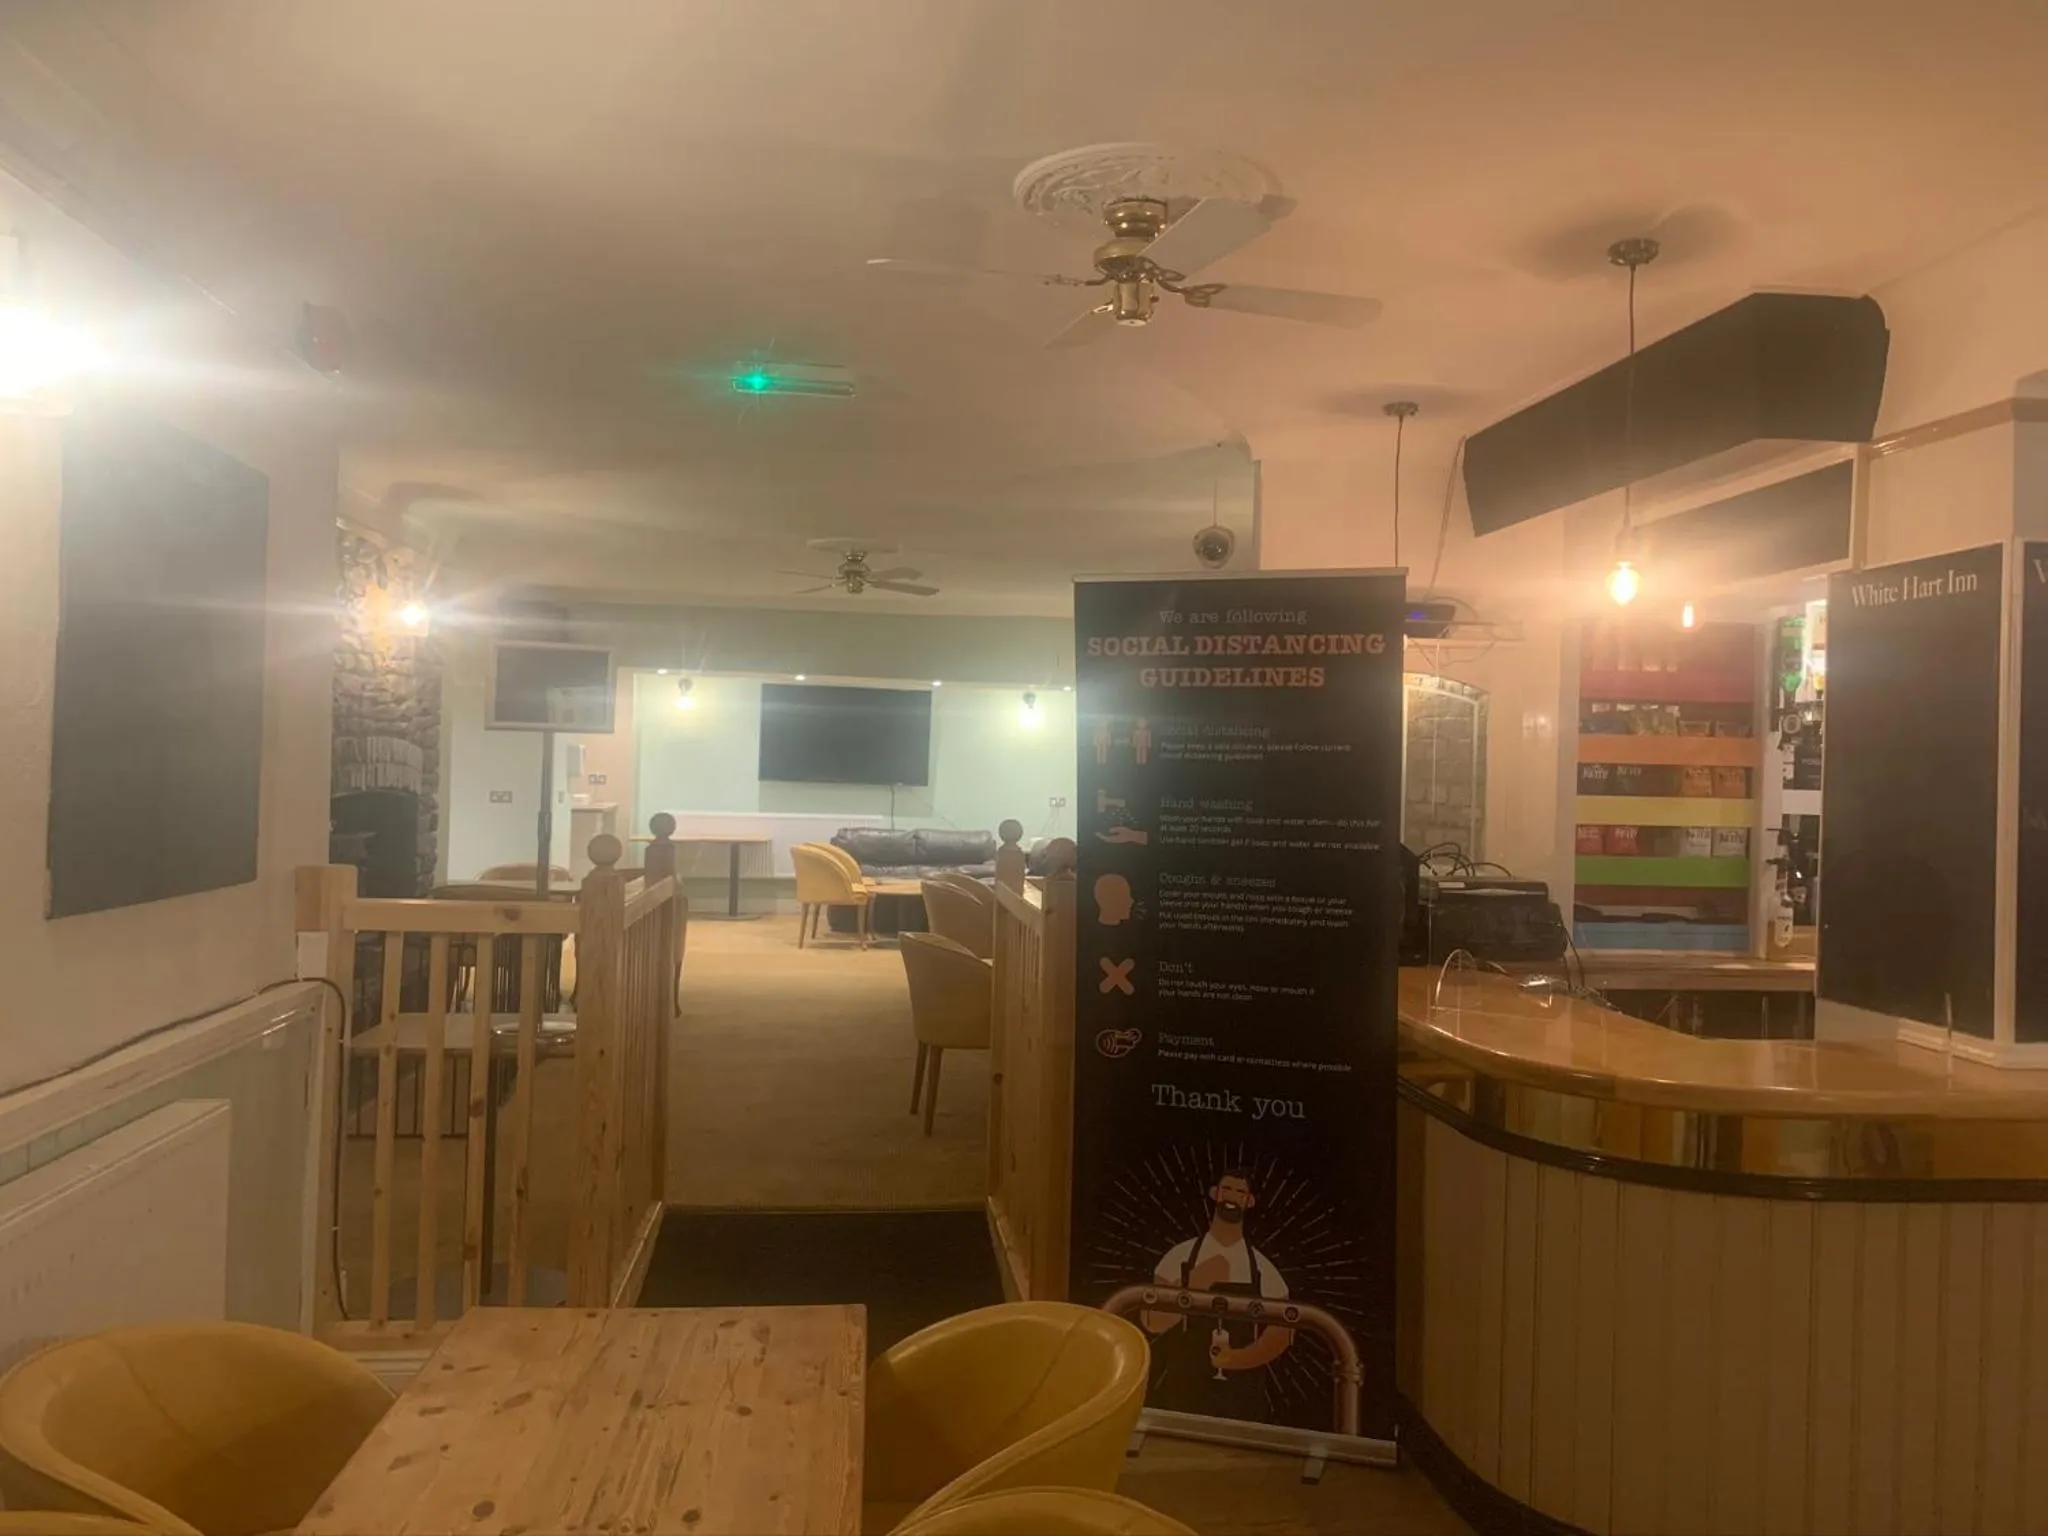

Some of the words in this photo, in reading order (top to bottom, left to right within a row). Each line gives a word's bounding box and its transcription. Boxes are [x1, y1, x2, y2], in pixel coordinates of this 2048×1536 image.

[1850, 583, 1900, 608] White
[1903, 575, 1945, 602] Hart
[1946, 568, 1979, 595] Inn
[1159, 609, 1183, 624] We
[1189, 612, 1219, 624] are
[1224, 608, 1308, 625] following
[1087, 635, 1191, 656] SOCIAL
[1194, 633, 1387, 655] DISTANCING
[1140, 667, 1326, 688] GUIDELINES
[1160, 797, 1194, 809] Hand
[1198, 798, 1254, 812] washing
[1210, 874, 1222, 886] &
[1158, 1032, 1215, 1047] Payment
[1151, 1083, 1243, 1113] Thank
[1251, 1095, 1307, 1120] you
